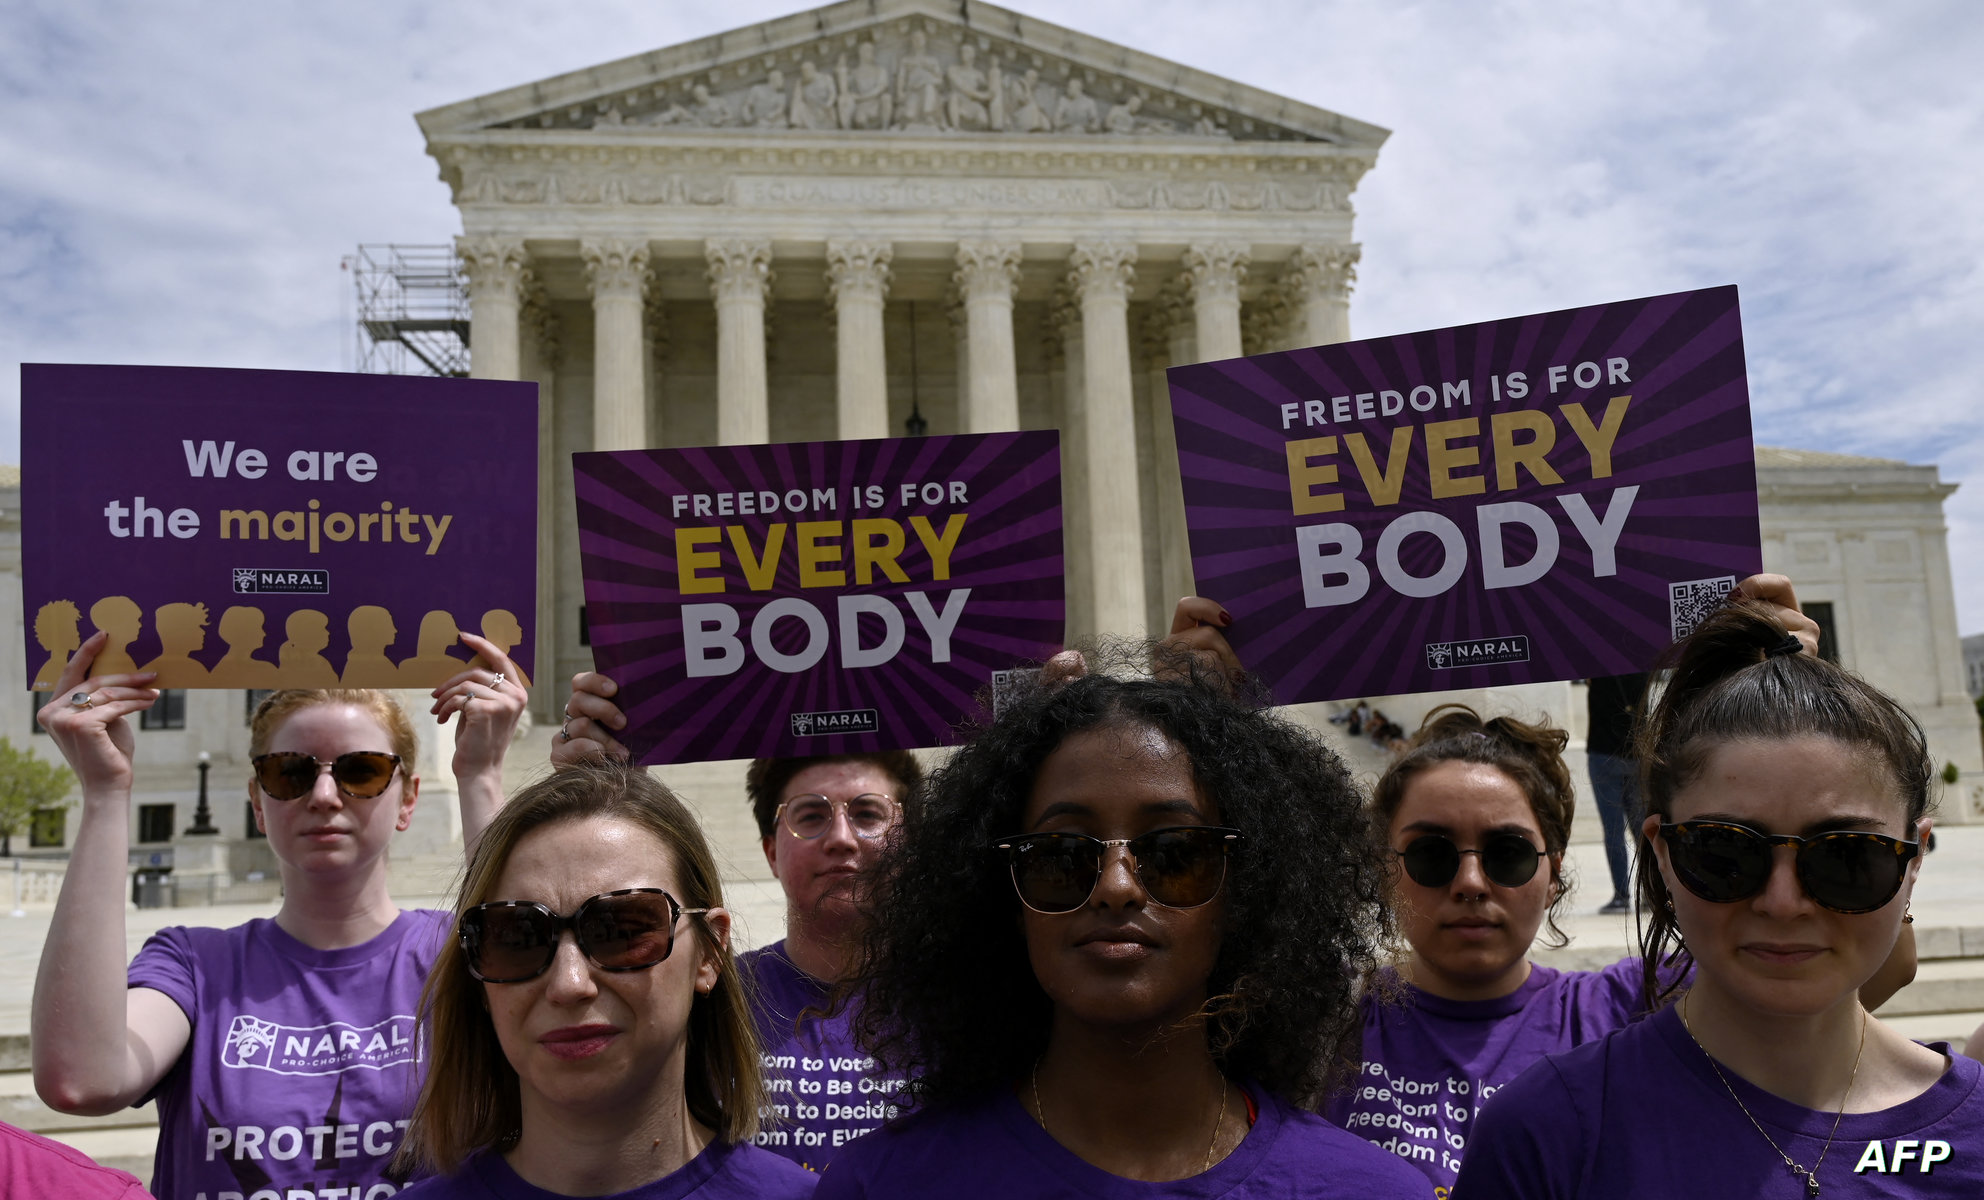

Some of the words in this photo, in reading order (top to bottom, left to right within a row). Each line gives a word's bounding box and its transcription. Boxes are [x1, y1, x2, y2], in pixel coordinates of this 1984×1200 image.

[1281, 379, 1472, 430] FREEDOM
[1491, 371, 1529, 401] IS
[1548, 357, 1632, 394] FOR
[183, 440, 268, 479] We
[287, 450, 378, 483] are
[1285, 394, 1633, 517] EVERY
[672, 488, 837, 518] FREEDOM
[853, 485, 885, 509] IS
[901, 480, 969, 507] FOR
[104, 497, 201, 539] the
[219, 499, 453, 556] majority
[674, 513, 969, 595] EVERY
[1295, 485, 1641, 609] BODY
[262, 573, 323, 585] NARAL
[681, 588, 972, 678] BODY
[1456, 641, 1522, 657] NARAL
[817, 713, 872, 726] NARAL
[284, 1025, 409, 1057] NARAL
[281, 1052, 354, 1067] PRO-CHOICE
[359, 1046, 410, 1061] AMERICA
[801, 1056, 824, 1072] to
[798, 1078, 822, 1094] to
[826, 1079, 853, 1095] Be
[1446, 1076, 1470, 1095] to
[796, 1102, 820, 1119] to
[825, 1100, 898, 1120] Decide
[1444, 1101, 1468, 1122] to
[794, 1127, 827, 1147] for
[1443, 1126, 1465, 1150] to
